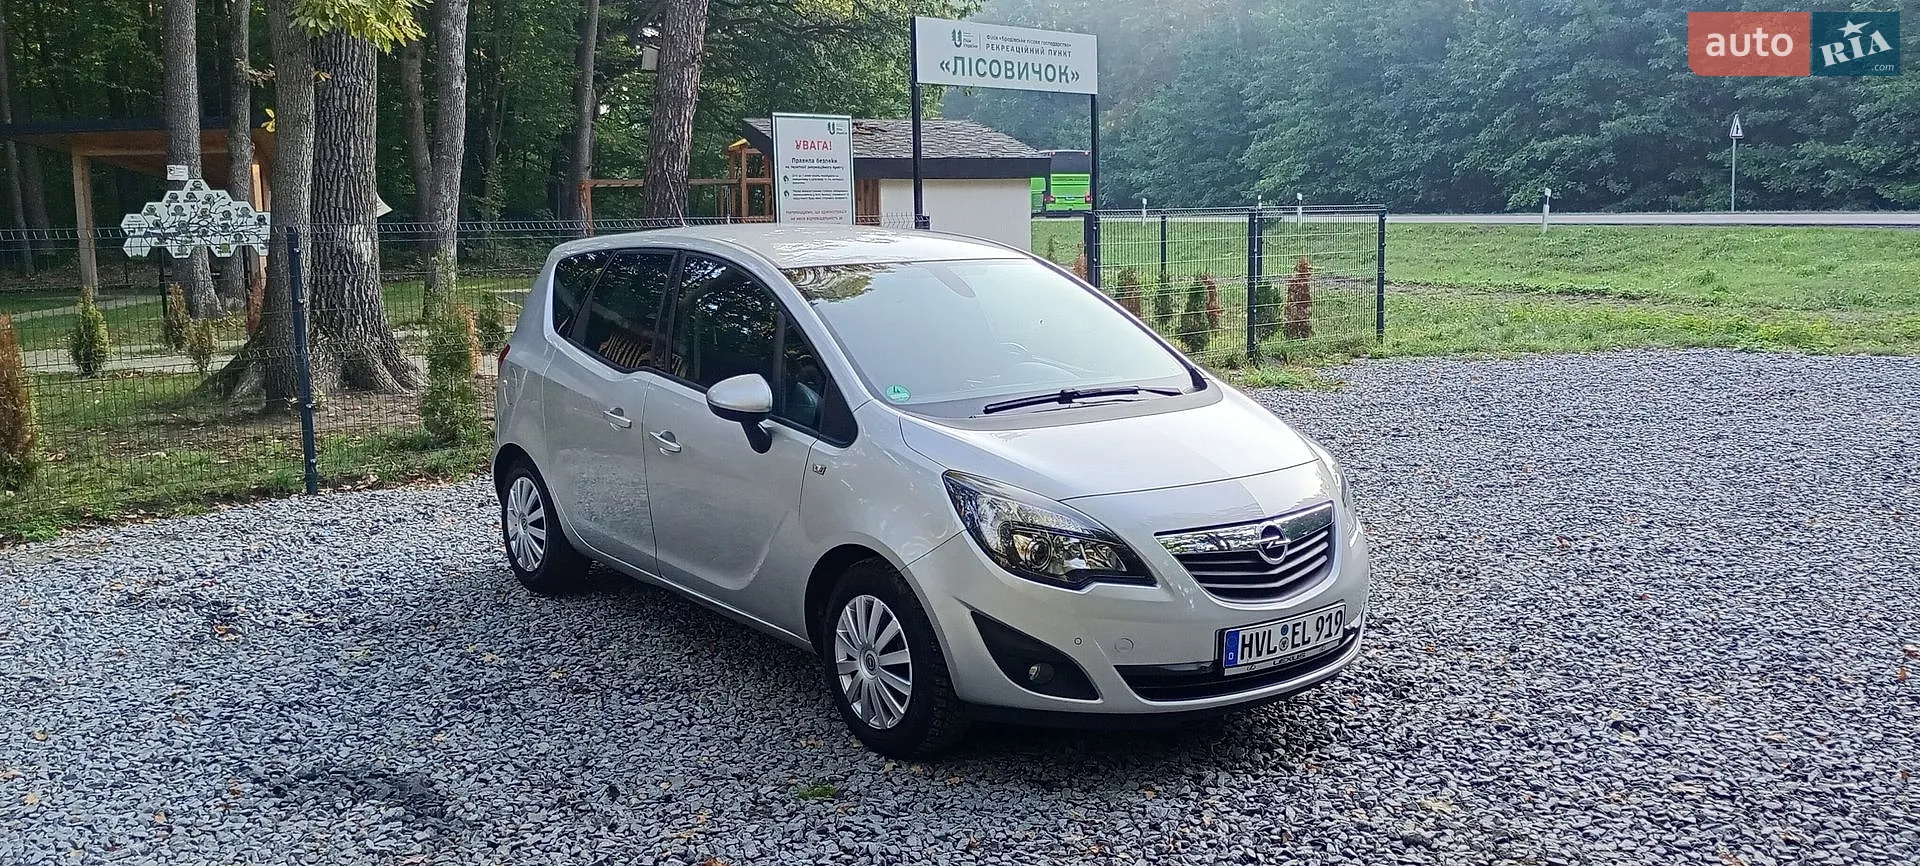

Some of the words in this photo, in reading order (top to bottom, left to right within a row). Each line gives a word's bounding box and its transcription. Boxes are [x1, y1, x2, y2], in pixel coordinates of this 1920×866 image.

[986, 44, 1045, 56] РЕКРЕАЦІЙНИЙ
[1048, 49, 1071, 58] ПУНКТ
[939, 55, 1080, 84] «ЛІСОВИЧОК»
[795, 140, 832, 150] УВАГА!
[1228, 652, 1234, 660] D
[1240, 630, 1278, 660] HVL
[1290, 620, 1311, 648] EL
[1315, 610, 1343, 642] 919
